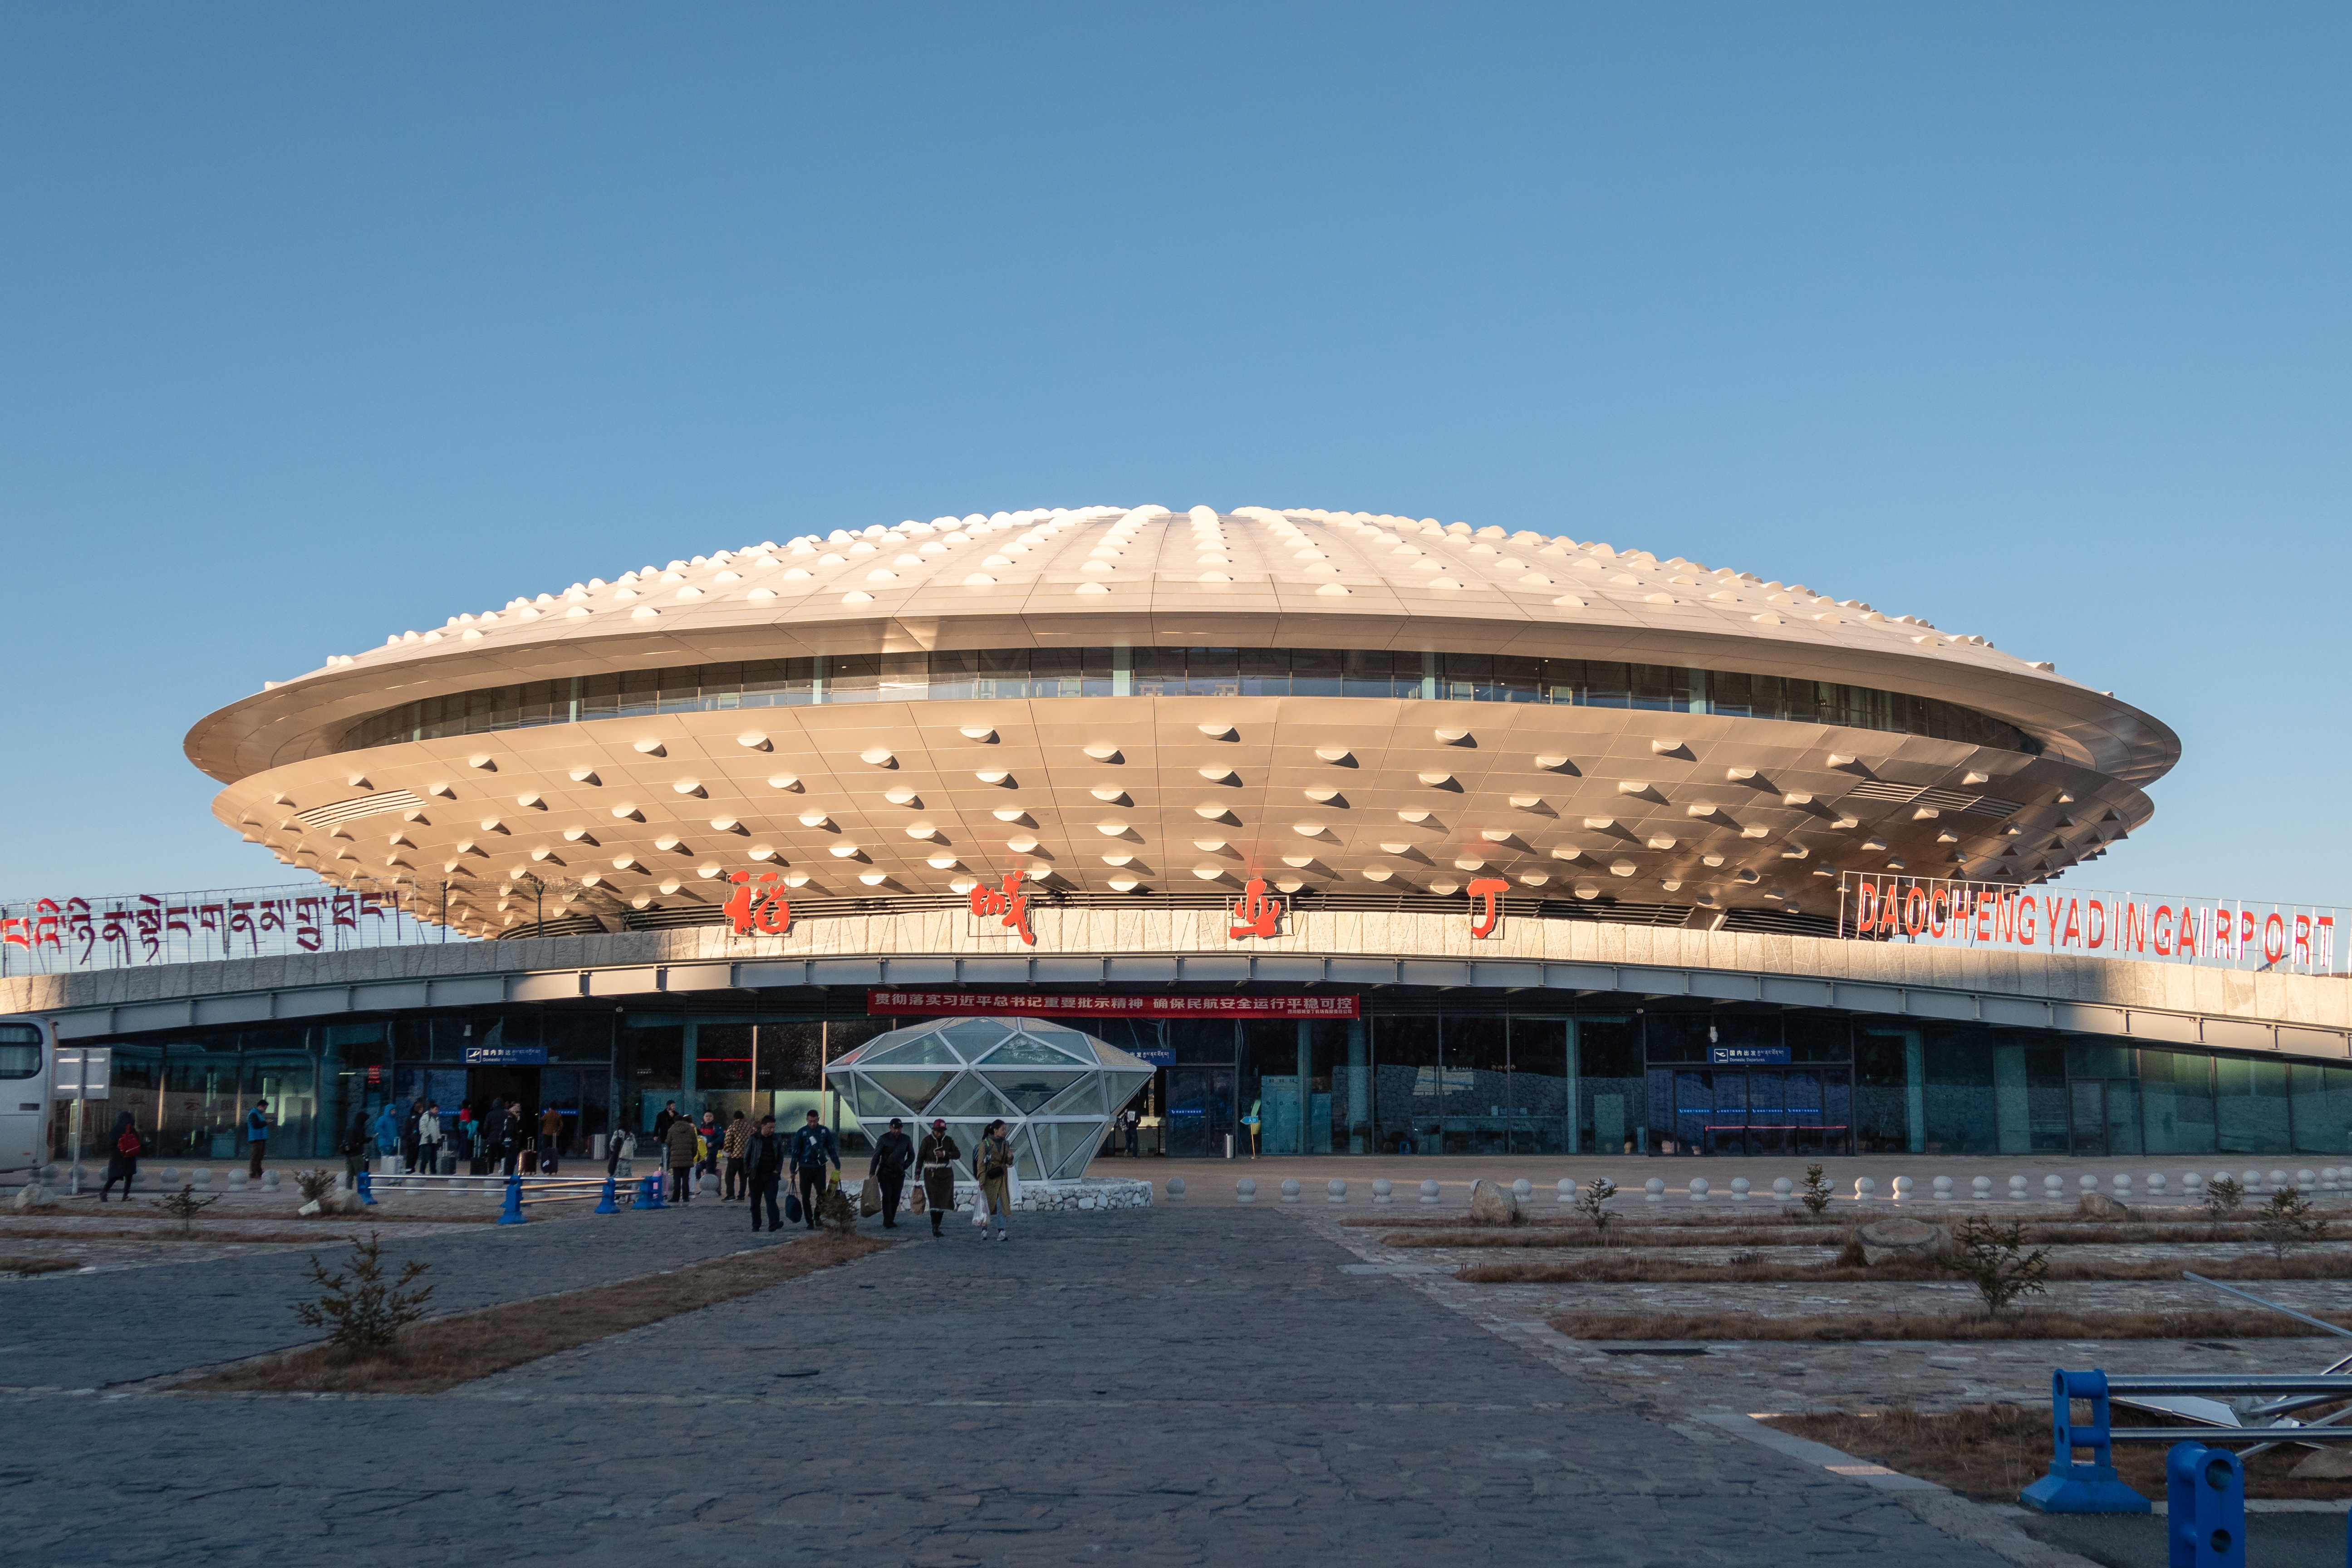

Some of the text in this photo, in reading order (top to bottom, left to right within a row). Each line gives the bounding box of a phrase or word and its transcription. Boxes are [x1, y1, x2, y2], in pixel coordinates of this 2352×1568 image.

[1858, 882, 2336, 967] DAOCHENG YADING AIRPORT
[874, 993, 1352, 1010] 贯彻落实习近平总书记重要批示精神 确保民航安全运行平稳可控
